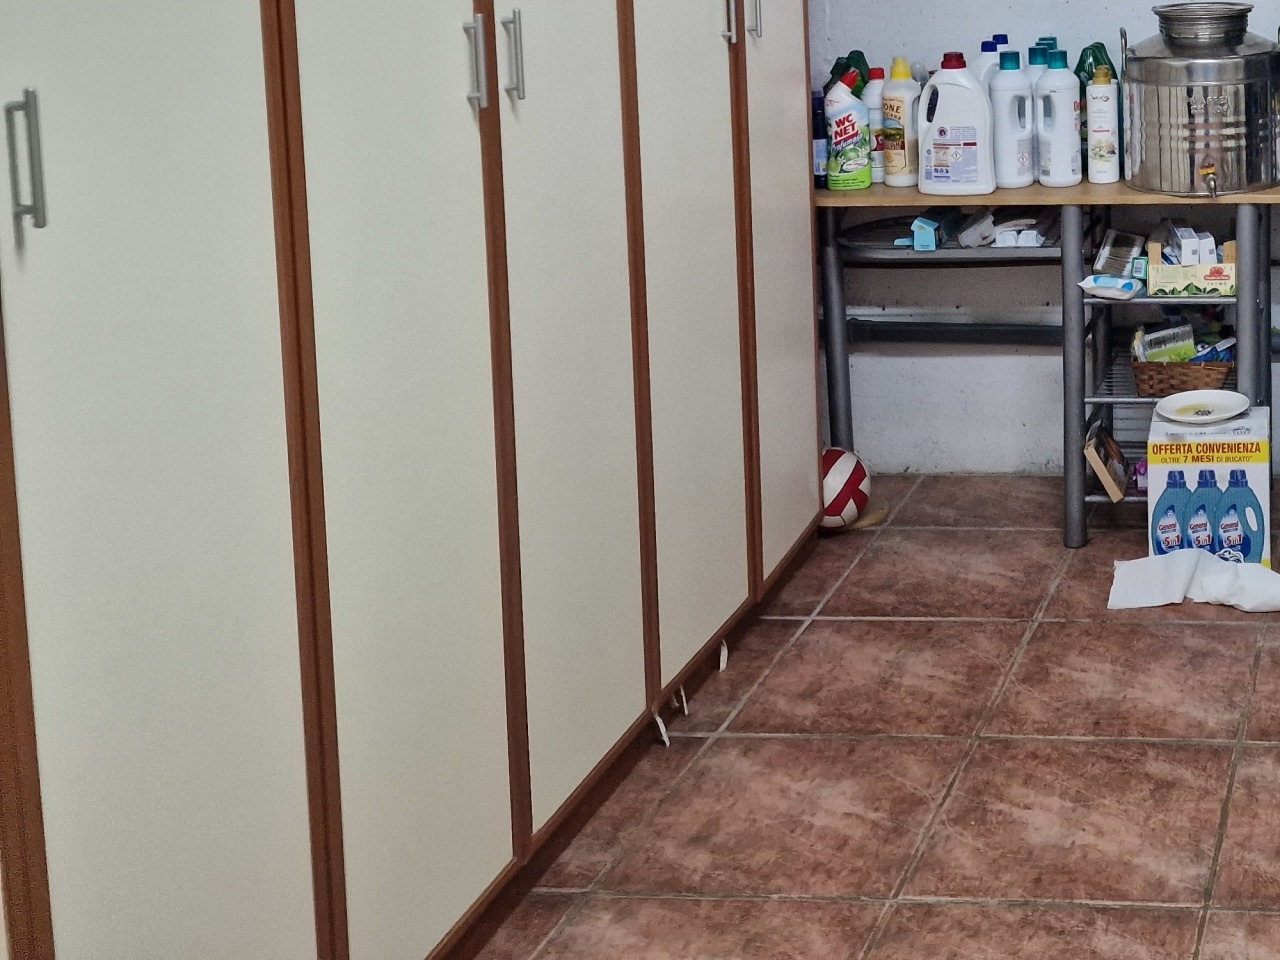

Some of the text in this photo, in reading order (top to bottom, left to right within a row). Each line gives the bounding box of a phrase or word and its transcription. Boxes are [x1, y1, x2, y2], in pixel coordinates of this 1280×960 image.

[834, 113, 853, 129] WC
[833, 121, 858, 139] NET
[1152, 442, 1261, 456] OFFERTA CONVENIENZA
[1160, 456, 1180, 464] OLTRE
[1183, 455, 1188, 463] 7
[1191, 455, 1214, 463] MESI
[1158, 521, 1177, 531] General
[1189, 521, 1207, 531] General
[1220, 520, 1239, 530] General
[1163, 534, 1182, 547] 5in1
[1194, 533, 1213, 546] 5in1
[1225, 533, 1243, 546] 5in1
